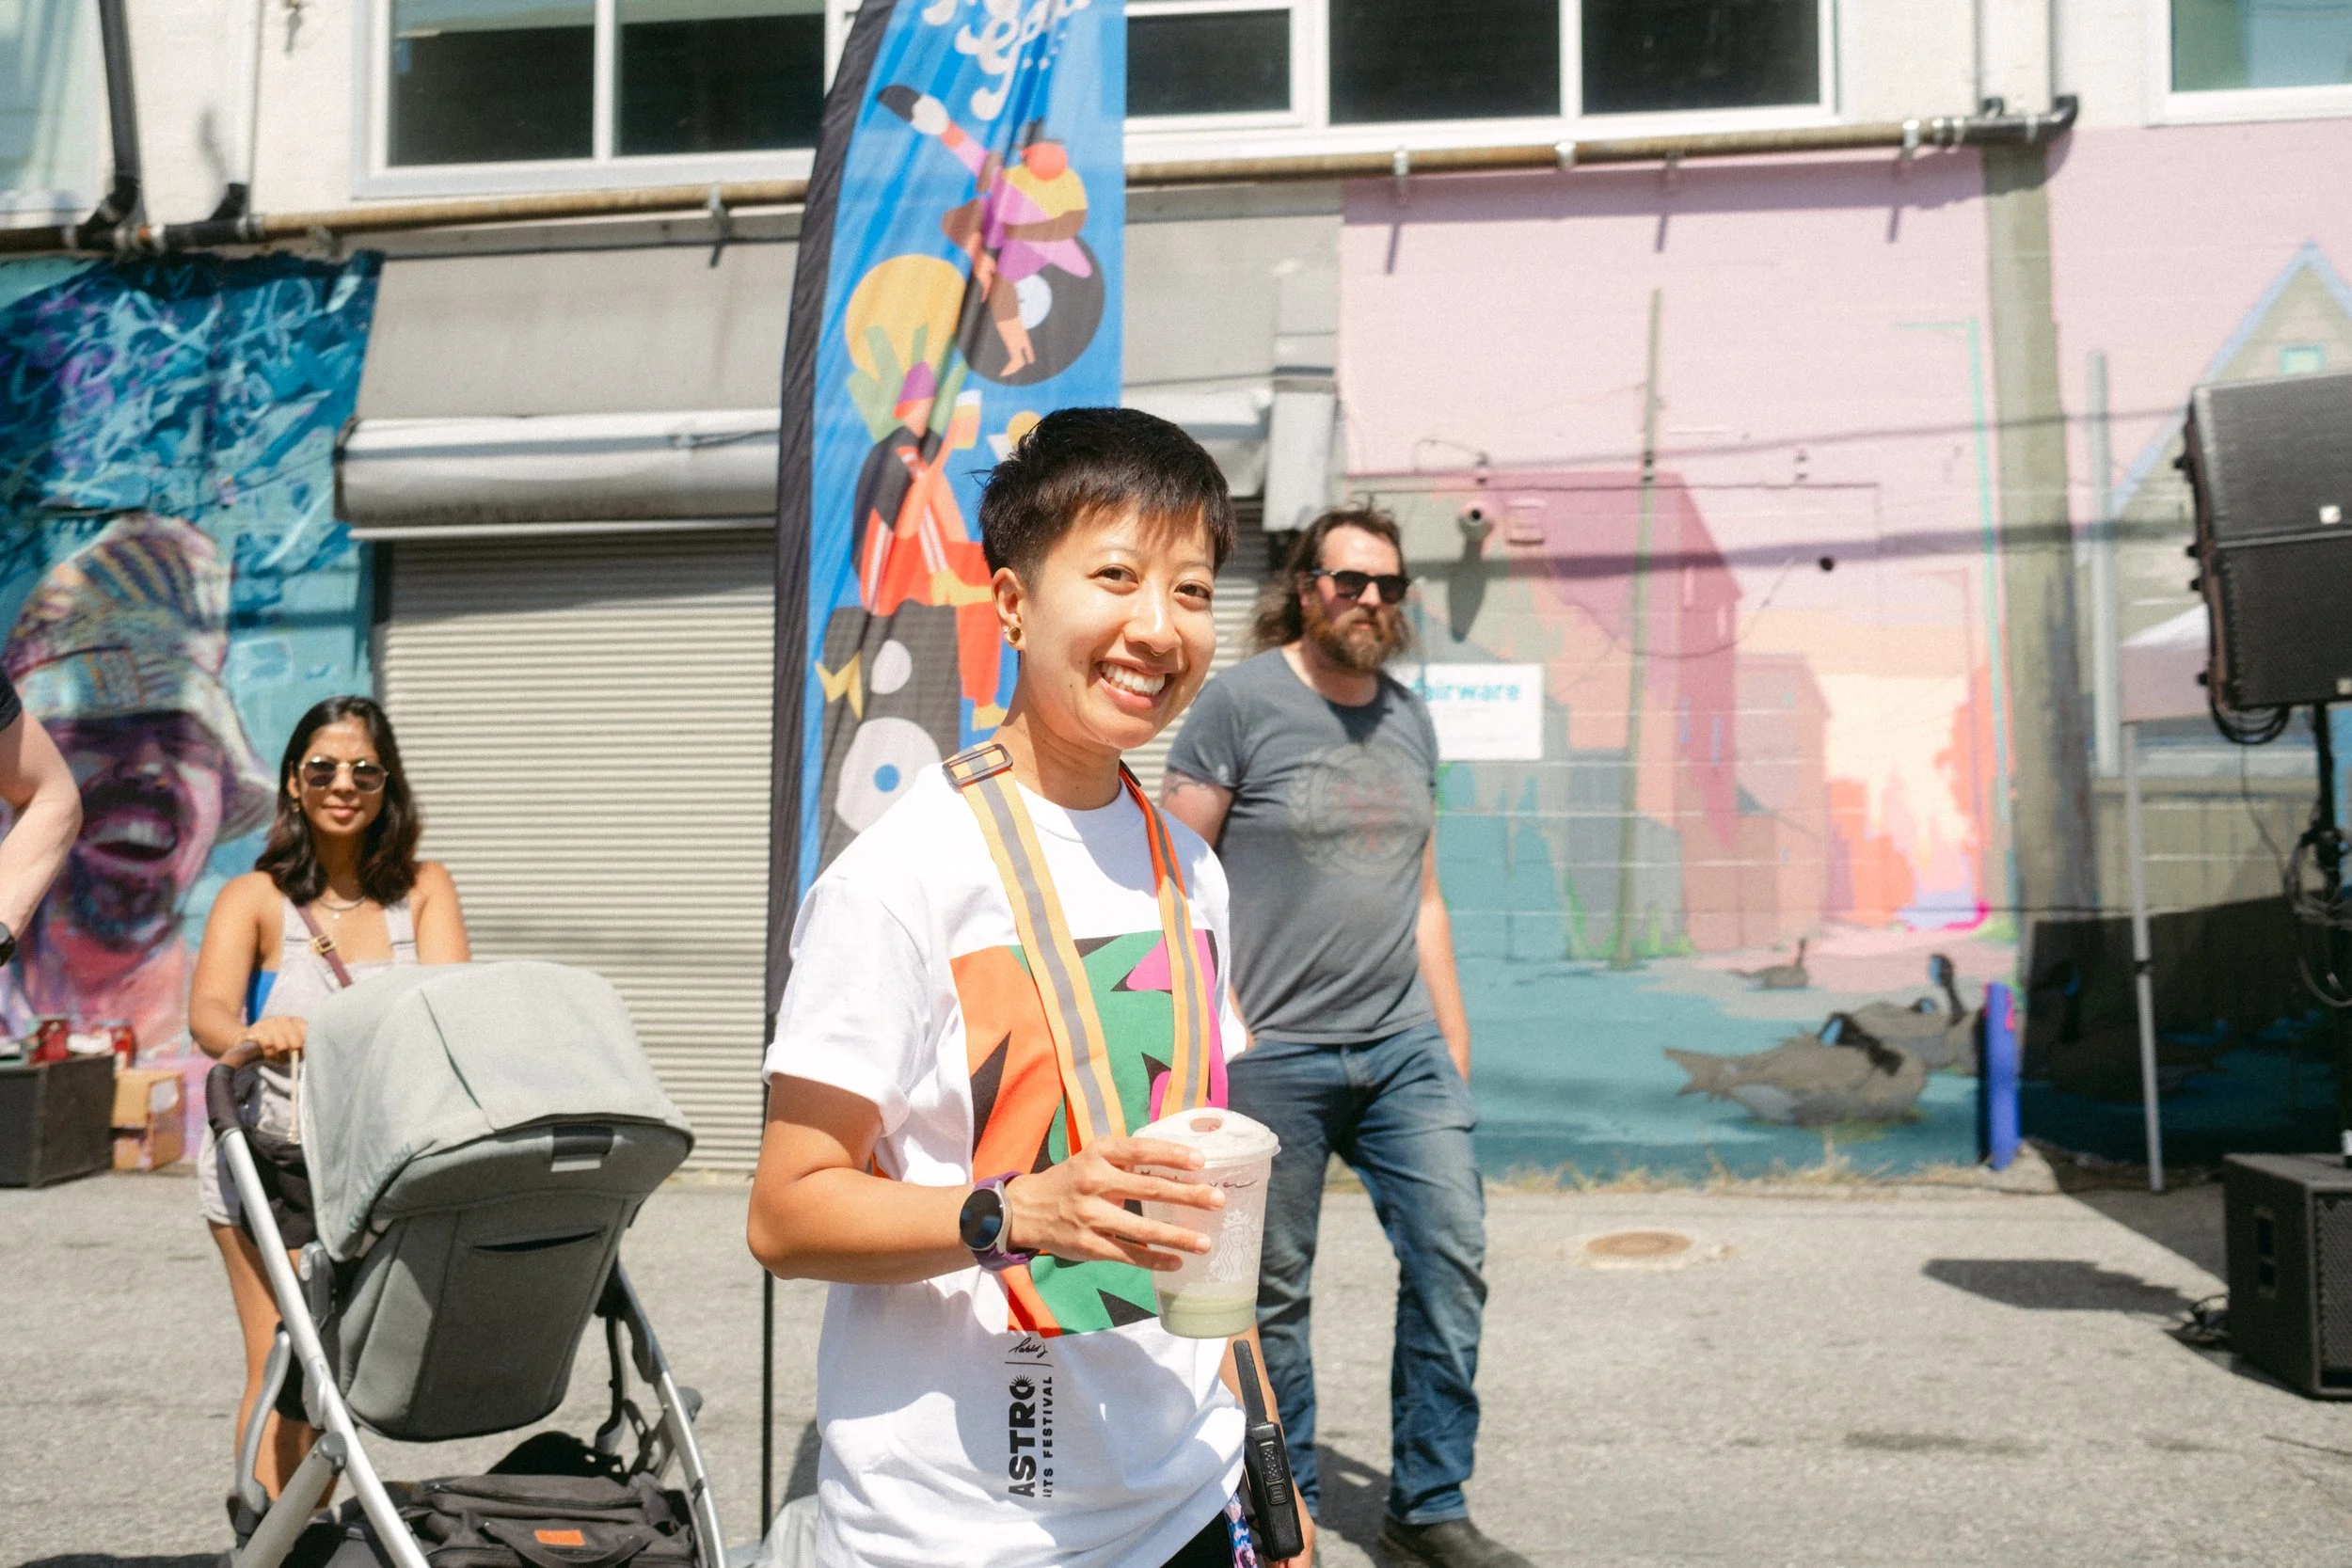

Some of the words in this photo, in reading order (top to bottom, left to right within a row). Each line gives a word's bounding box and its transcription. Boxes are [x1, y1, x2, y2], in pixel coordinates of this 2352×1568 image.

[1009, 1374, 1037, 1497] ASTRO
[1042, 1376, 1053, 1459] FESTIVAL
[1042, 1467, 1054, 1497] ARTS
